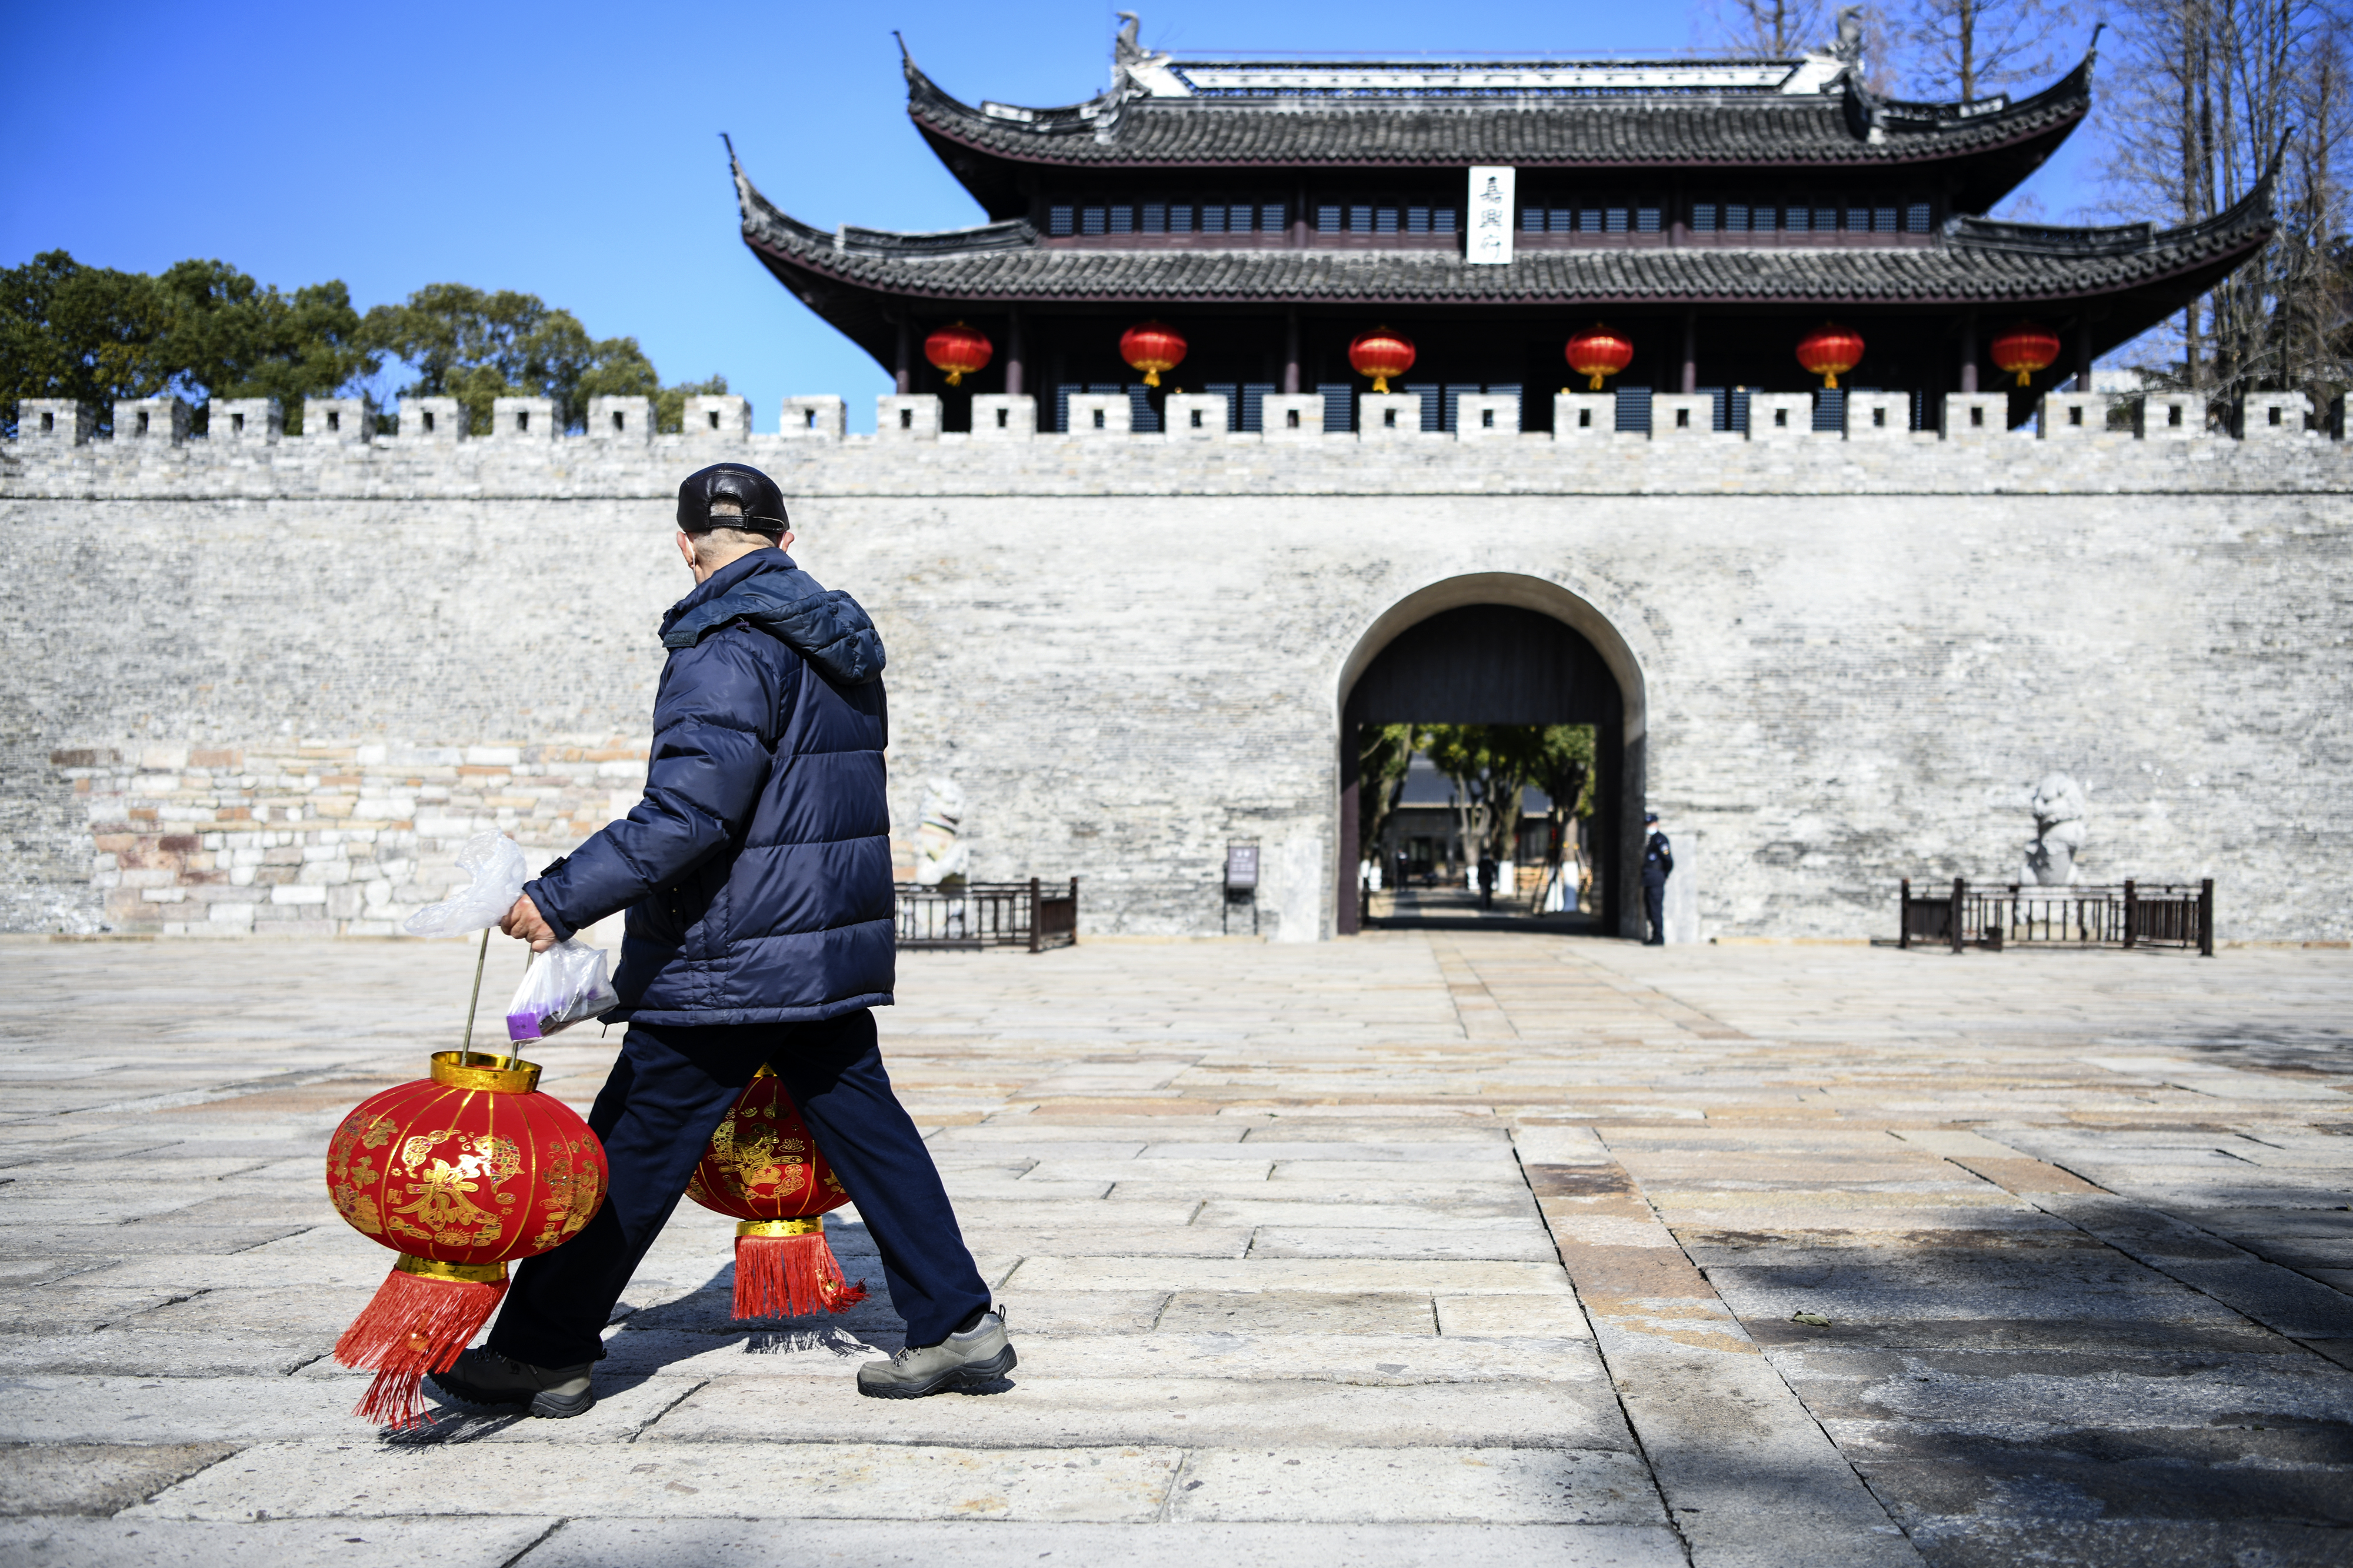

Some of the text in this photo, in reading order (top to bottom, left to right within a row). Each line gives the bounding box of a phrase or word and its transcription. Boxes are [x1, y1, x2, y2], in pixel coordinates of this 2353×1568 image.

[1479, 176, 1505, 259] 嘉興府
[392, 1154, 499, 1231] 恭
